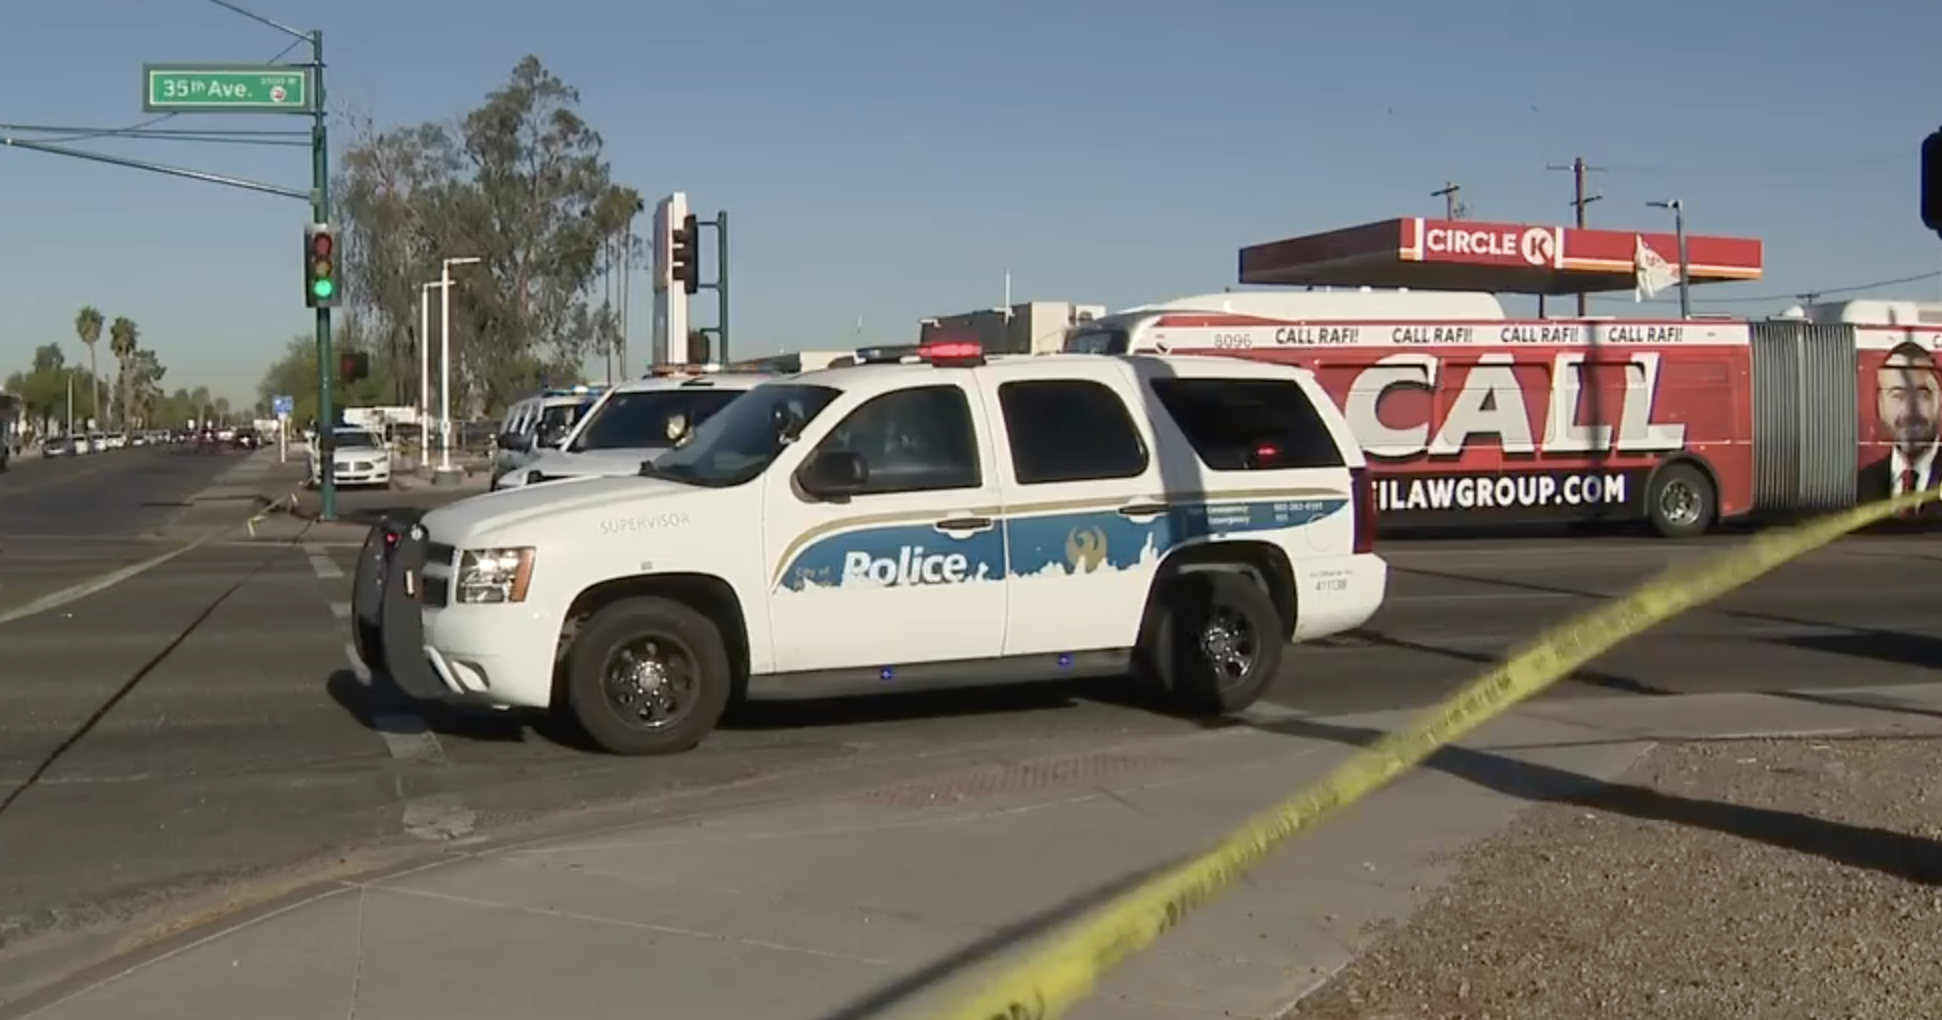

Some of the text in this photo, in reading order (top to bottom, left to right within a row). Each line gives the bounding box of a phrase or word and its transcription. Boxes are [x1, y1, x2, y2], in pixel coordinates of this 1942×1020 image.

[163, 79, 252, 97] 35th Ave.
[1427, 229, 1516, 255] CIRCLE
[1214, 333, 1252, 347] 8096
[1275, 328, 1359, 344] CALL RAFI!
[1392, 328, 1473, 343] CALL RAFI!
[1500, 327, 1579, 342] CALL RAFI!
[1608, 327, 1683, 342] CALL RAFI!
[1345, 352, 1687, 460] CALL
[1371, 475, 1625, 513] ILAWGROUP.COM
[600, 512, 690, 534] SUPERVISOR
[841, 546, 967, 589] Police
